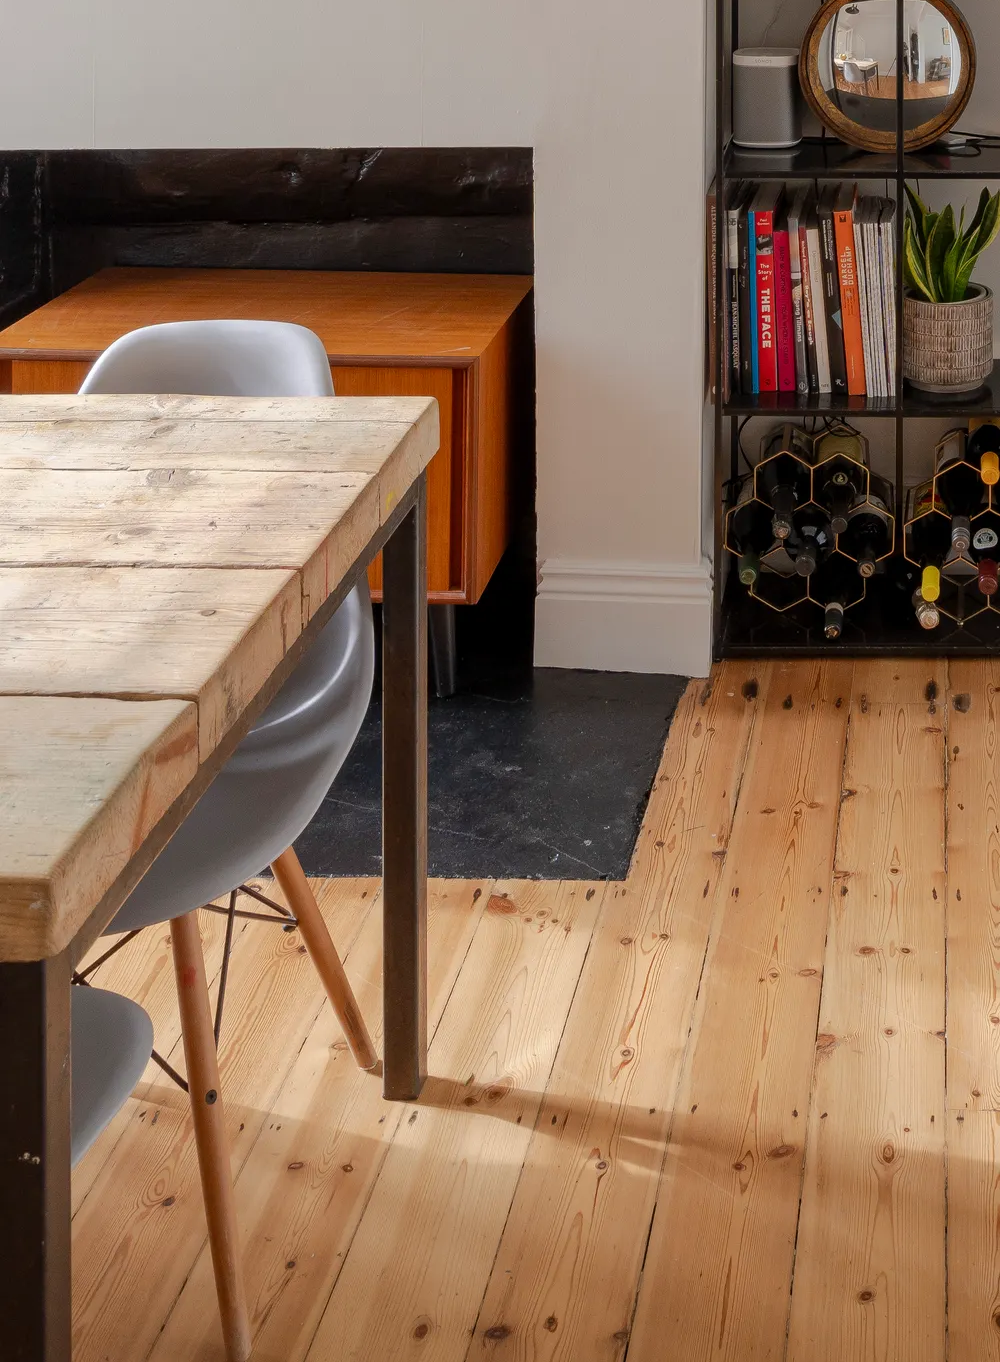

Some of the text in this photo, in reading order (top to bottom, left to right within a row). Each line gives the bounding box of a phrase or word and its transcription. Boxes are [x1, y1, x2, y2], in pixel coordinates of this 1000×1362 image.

[840, 252, 849, 286] MARCEL
[845, 246, 854, 285] DUCHAMP
[760, 288, 772, 349] THE FACE
[792, 286, 803, 342] Wolfgang Tillmans
[731, 340, 739, 369] BASQUIAT
